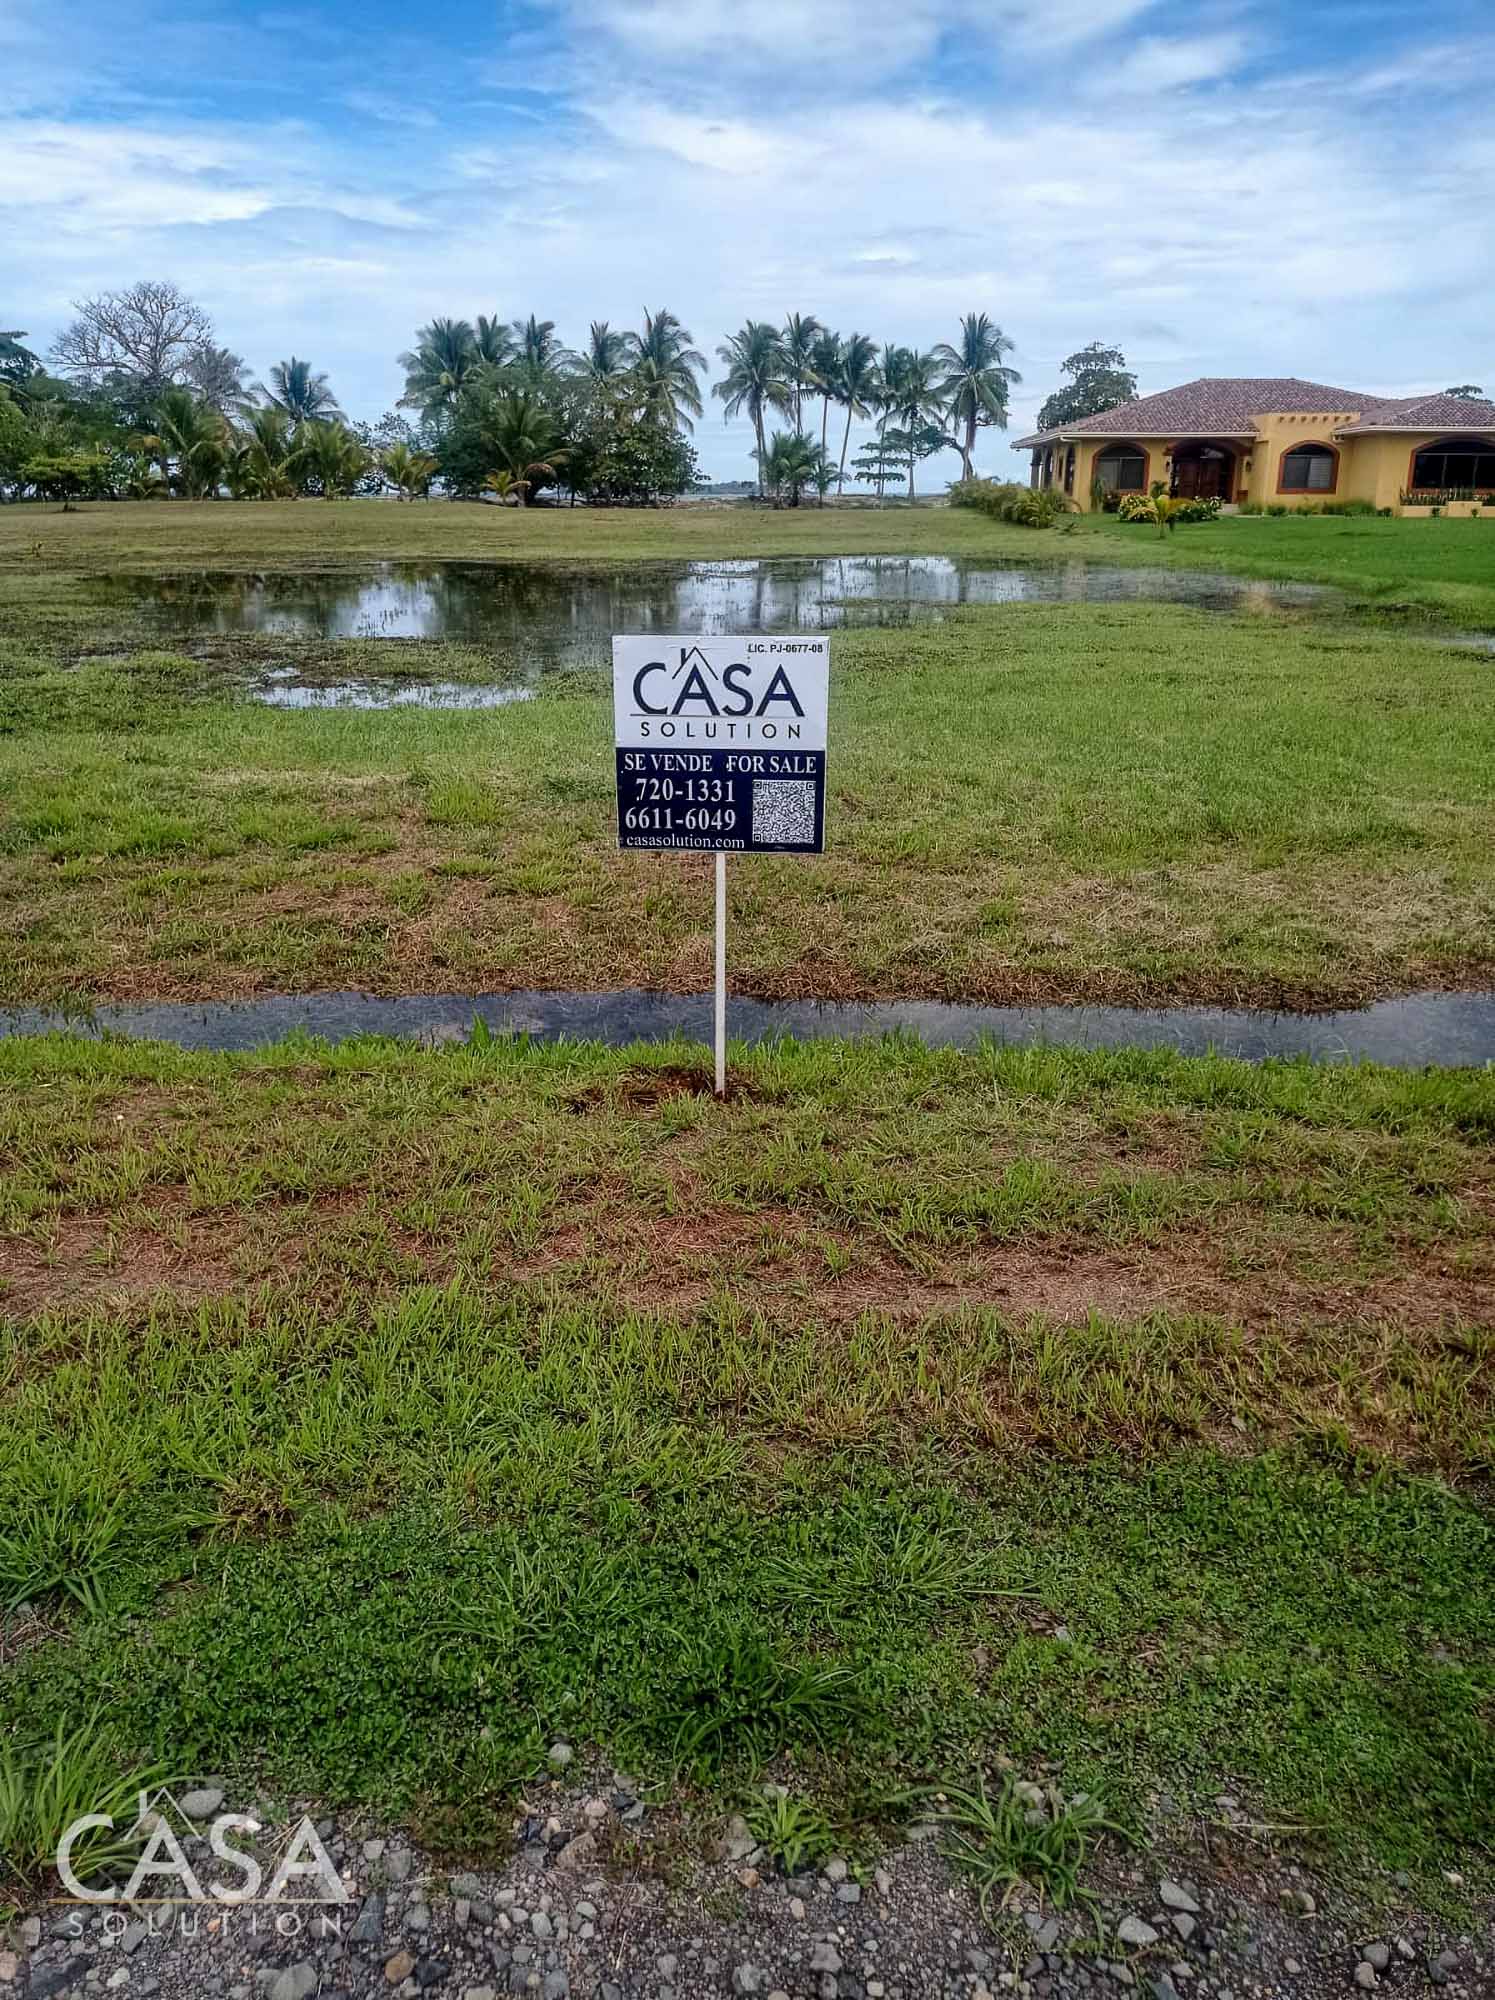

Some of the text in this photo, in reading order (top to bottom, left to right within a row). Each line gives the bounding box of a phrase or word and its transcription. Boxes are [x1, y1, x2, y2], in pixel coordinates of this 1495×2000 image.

[748, 644, 767, 653] LIC.
[633, 662, 805, 716] CASA
[640, 721, 801, 739] SOLUTION
[624, 753, 817, 774] SE VENDE FOR SALE
[635, 778, 736, 802] 720-1331
[625, 806, 736, 831] 6611-6049
[626, 833, 745, 849] casasolution.com
